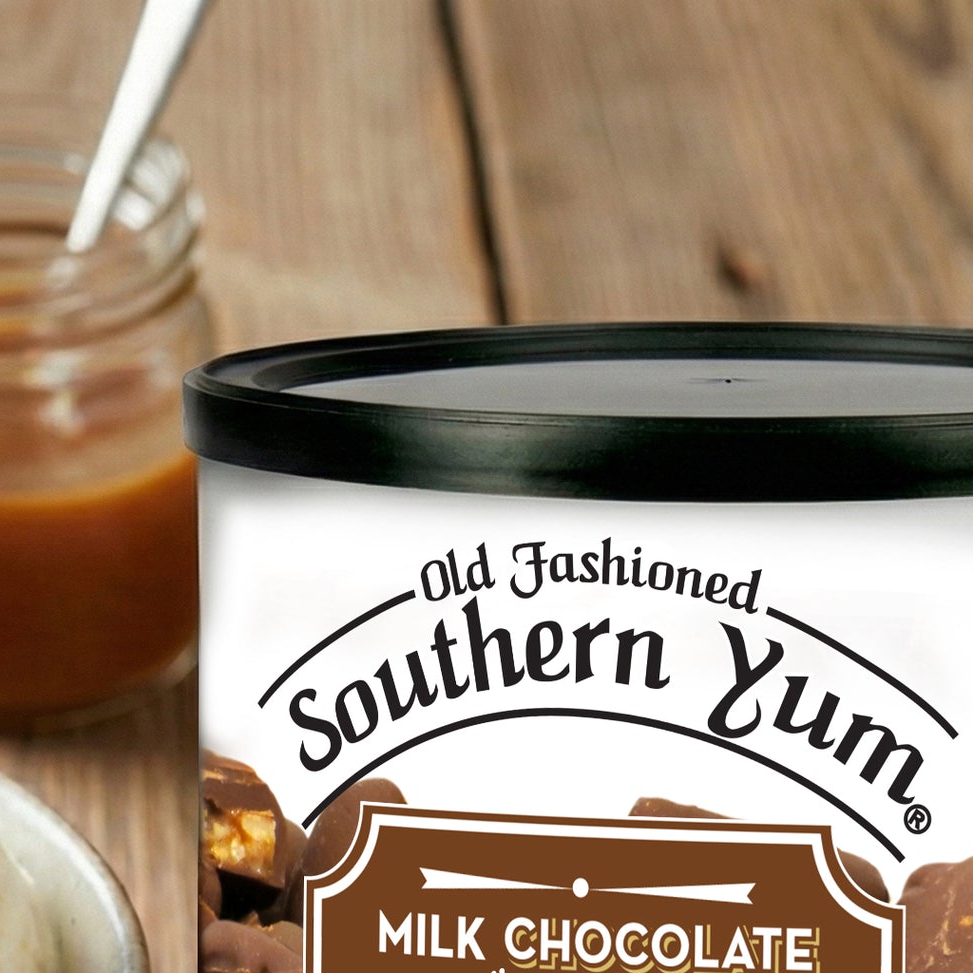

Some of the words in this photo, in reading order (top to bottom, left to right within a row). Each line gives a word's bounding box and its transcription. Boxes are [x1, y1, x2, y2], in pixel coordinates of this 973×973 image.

[419, 542, 495, 602] Old
[510, 537, 762, 614] Fashioned
[289, 597, 670, 772] Southern
[378, 909, 486, 960] MILK
